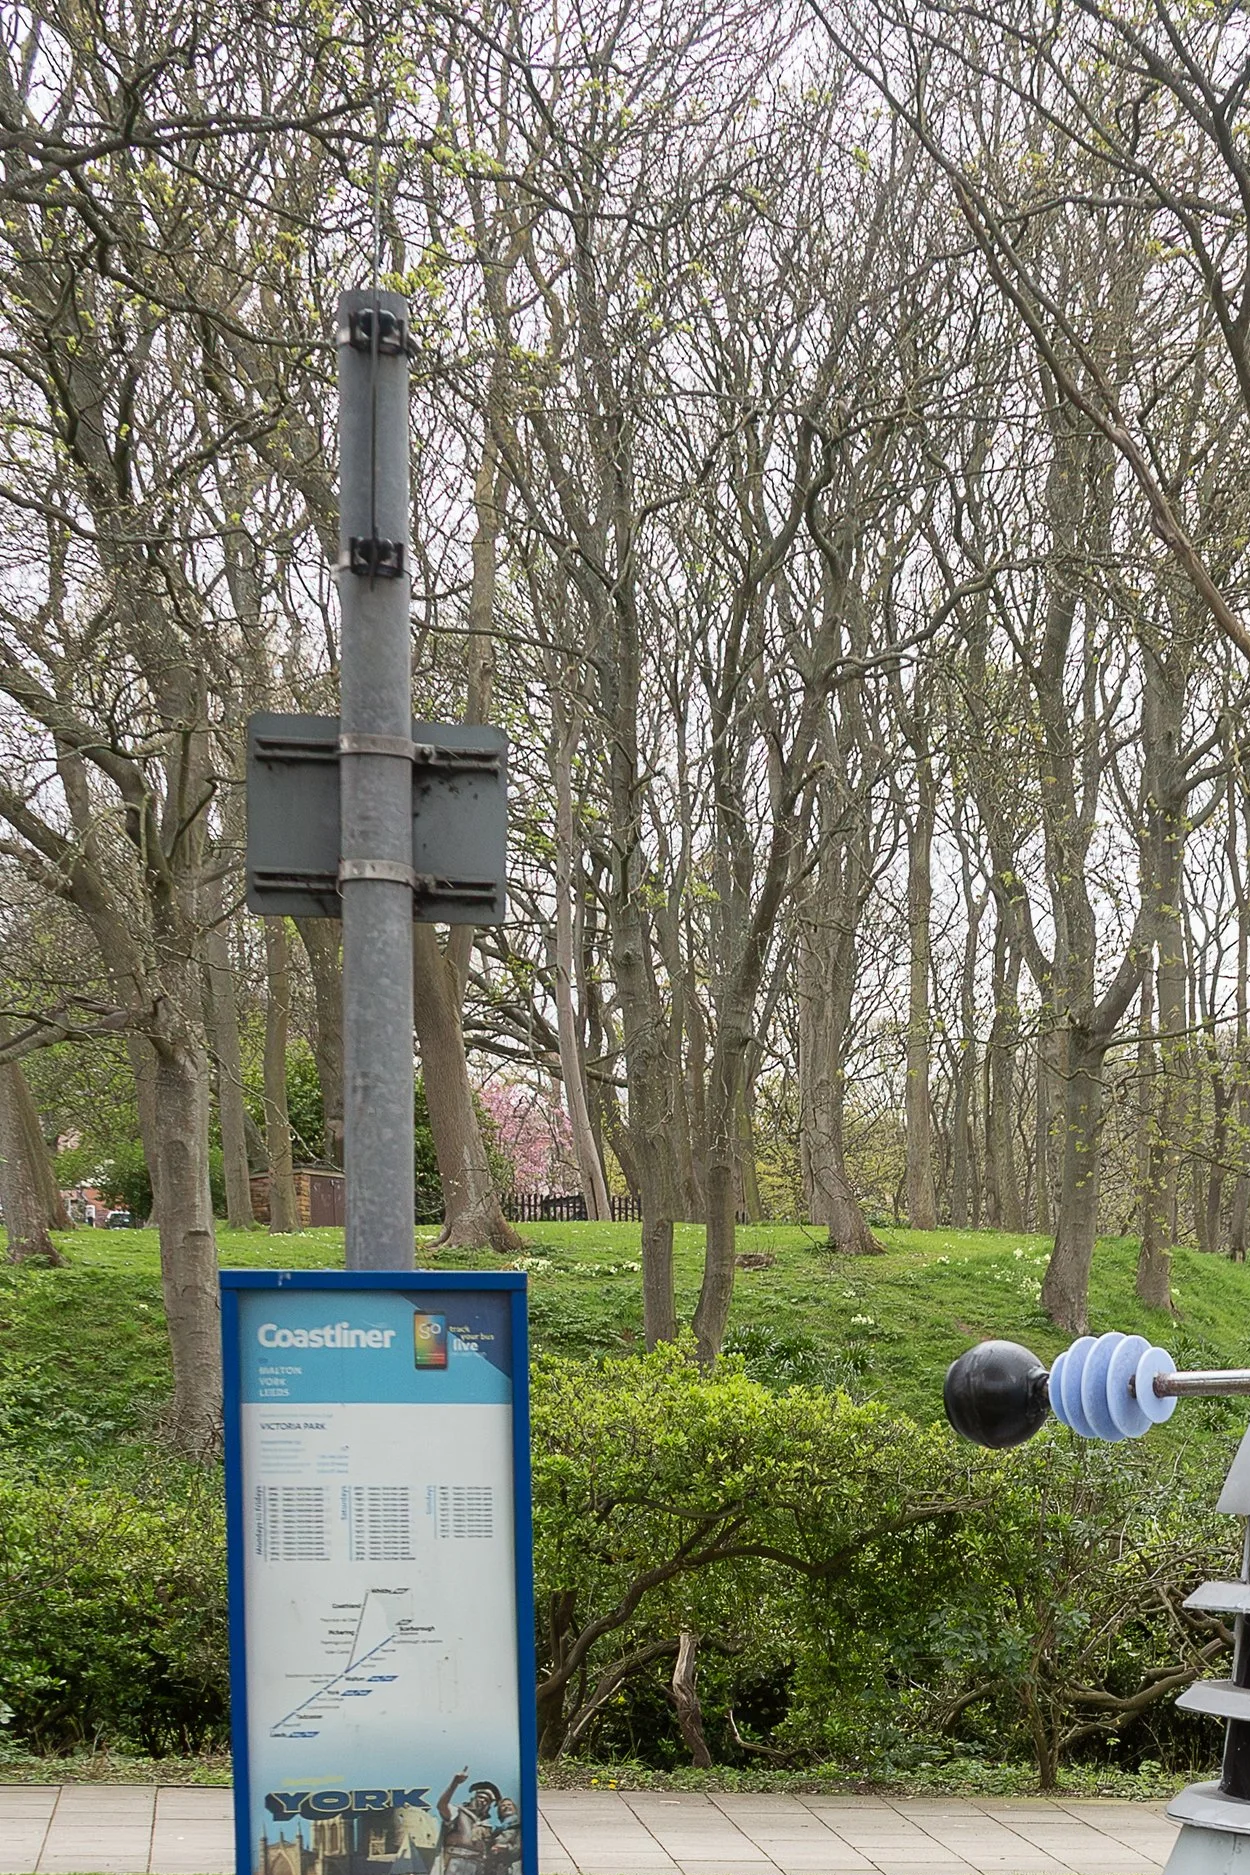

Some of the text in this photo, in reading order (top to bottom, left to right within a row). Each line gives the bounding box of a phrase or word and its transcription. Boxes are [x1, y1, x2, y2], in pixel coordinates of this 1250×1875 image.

[448, 1325, 470, 1333] track
[257, 1321, 397, 1349] Coastliner
[461, 1332, 495, 1341] your bus
[453, 1338, 479, 1351] live
[258, 1366, 303, 1375] MALTON
[258, 1377, 288, 1386] YORK
[259, 1388, 291, 1397] LEEDS
[260, 1422, 327, 1431] VICTORIA PARK
[266, 1788, 432, 1818] YORK
